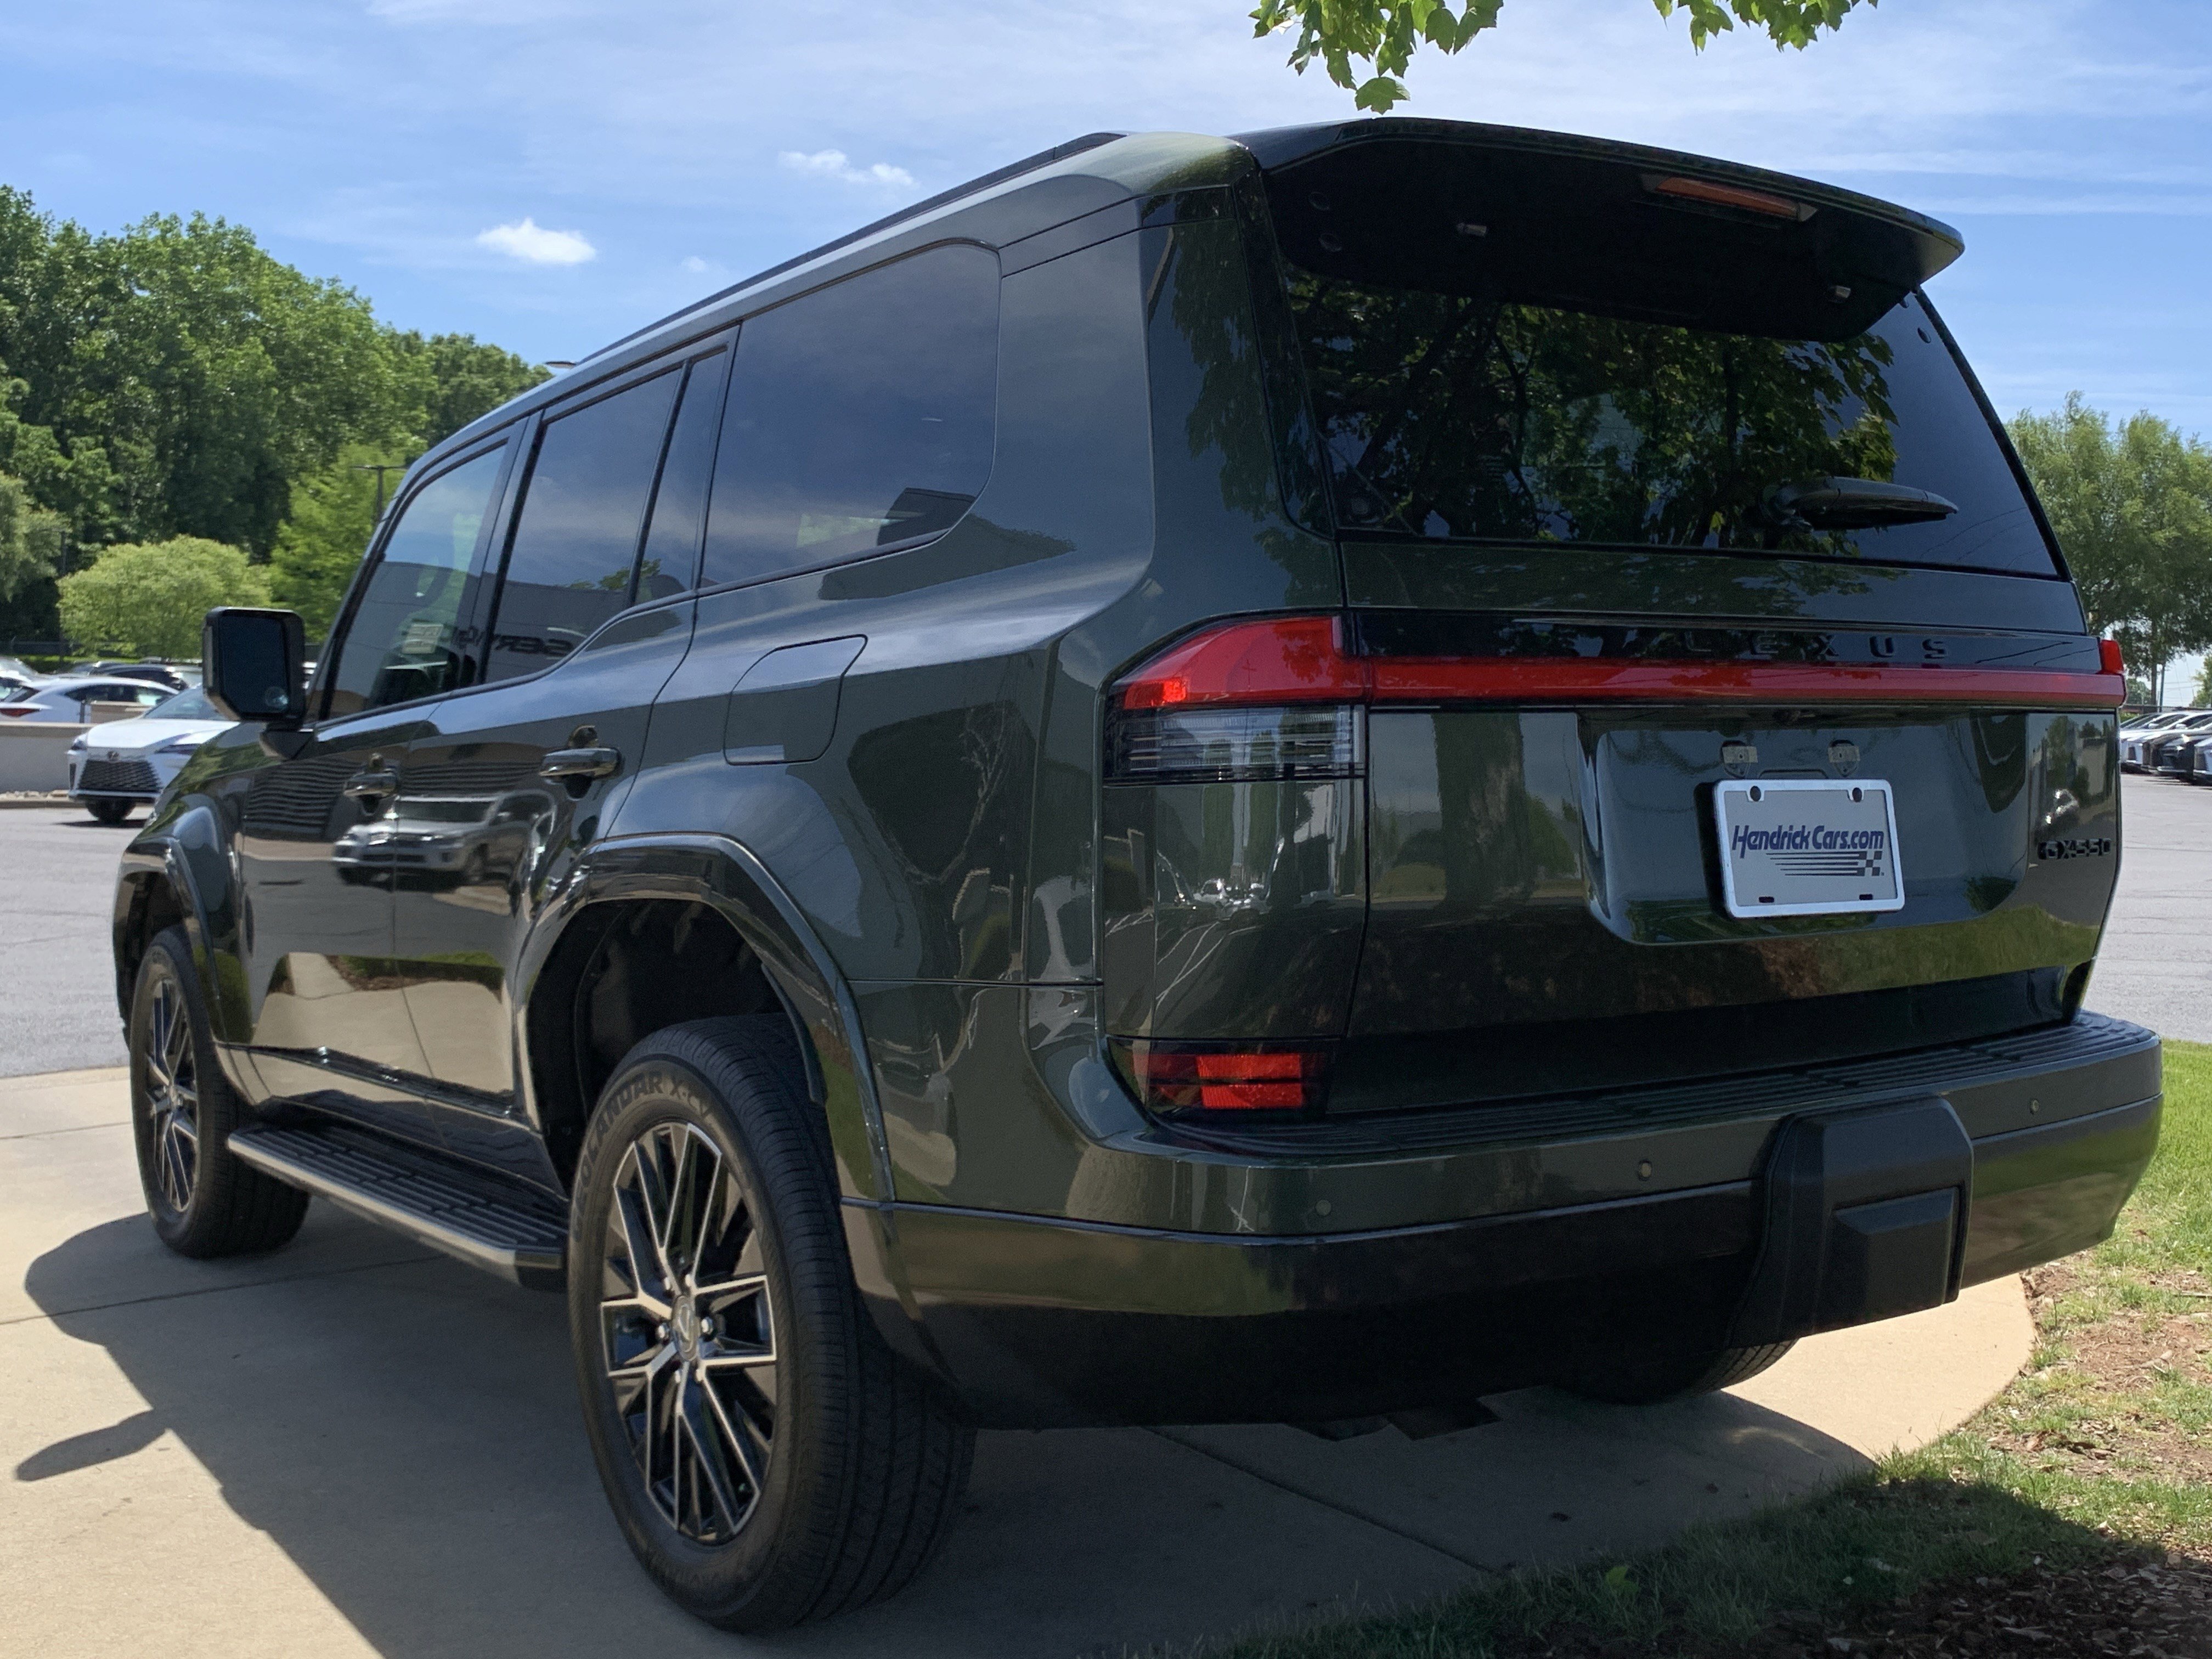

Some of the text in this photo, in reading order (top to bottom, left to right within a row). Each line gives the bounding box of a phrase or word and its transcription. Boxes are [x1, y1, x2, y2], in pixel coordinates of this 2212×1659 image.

[1683, 631, 1947, 659] LEXUS
[2038, 838, 2112, 860] GX550
[572, 1071, 663, 1242] GEOLANDAR
